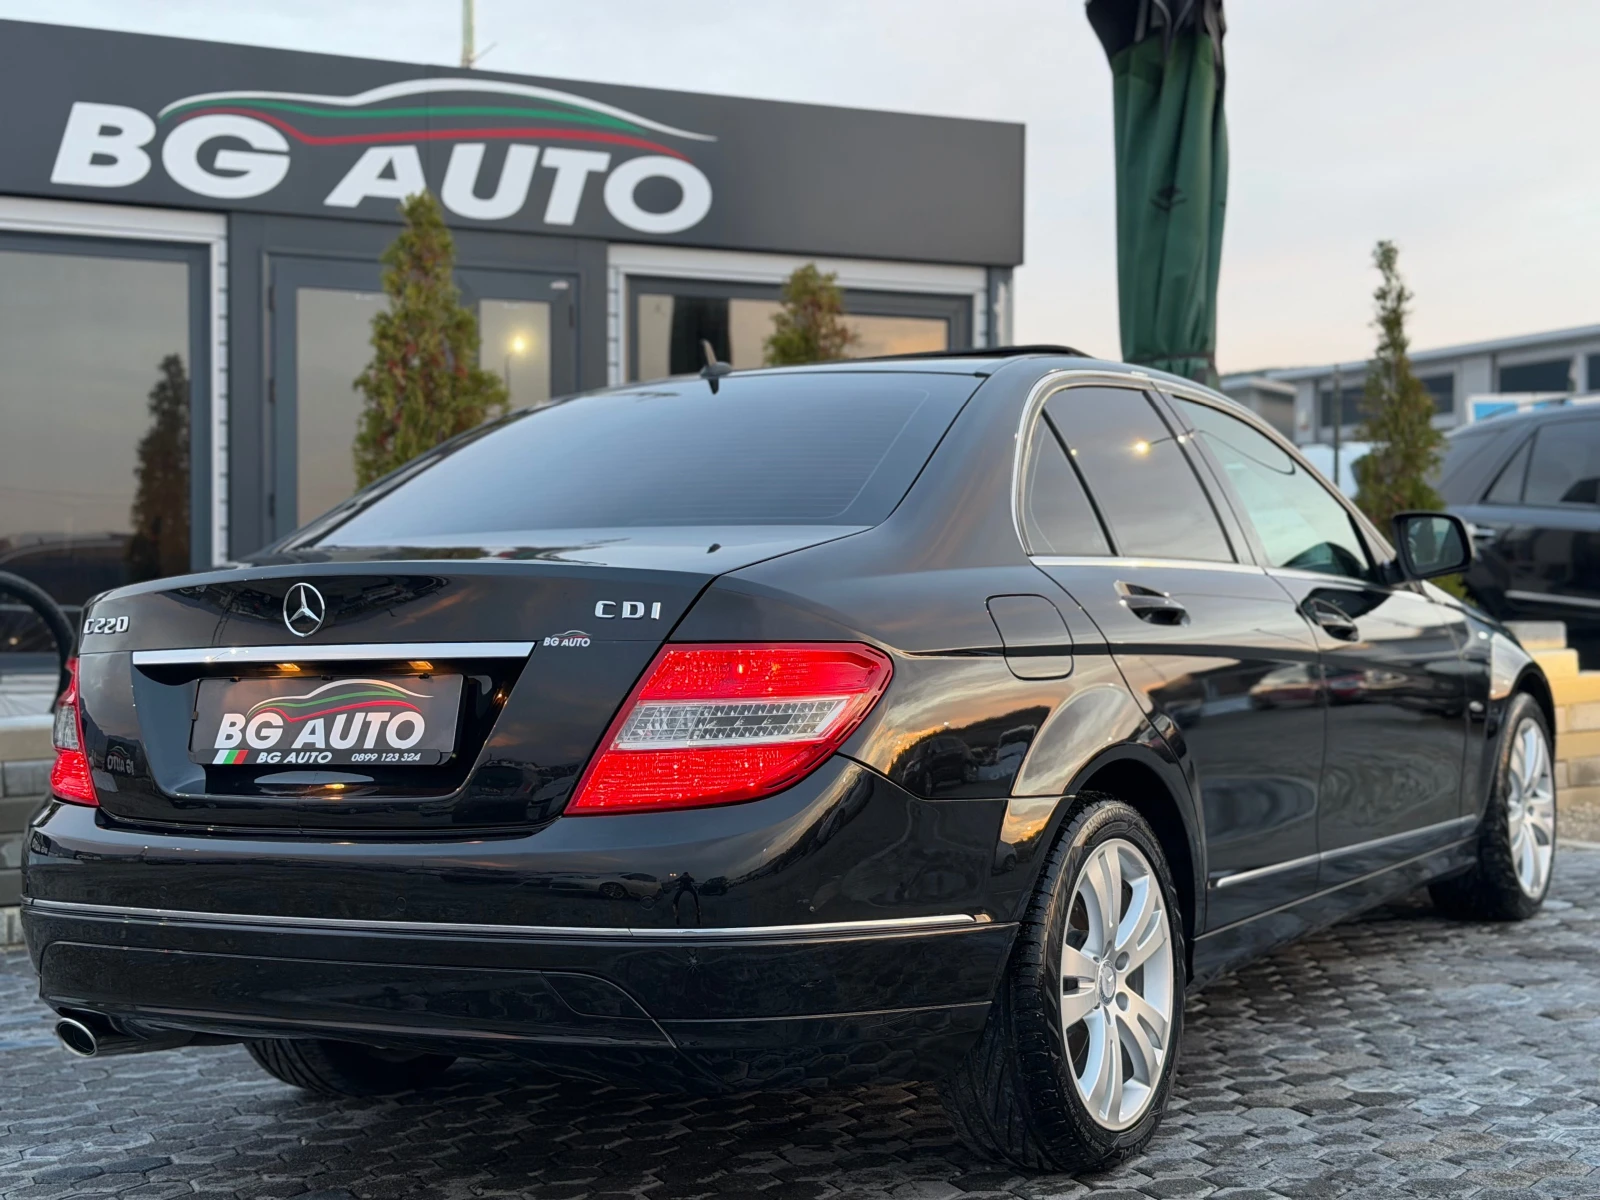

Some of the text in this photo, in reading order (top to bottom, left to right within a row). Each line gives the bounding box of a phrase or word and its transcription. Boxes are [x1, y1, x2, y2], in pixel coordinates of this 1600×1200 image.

[50, 102, 713, 234] BG AUTO
[595, 600, 661, 620] CDI
[543, 637, 590, 647] BG AUTO
[214, 711, 425, 749] BG AUTO
[256, 751, 332, 764] BG AUTO
[351, 752, 420, 762] 0899 123 324
